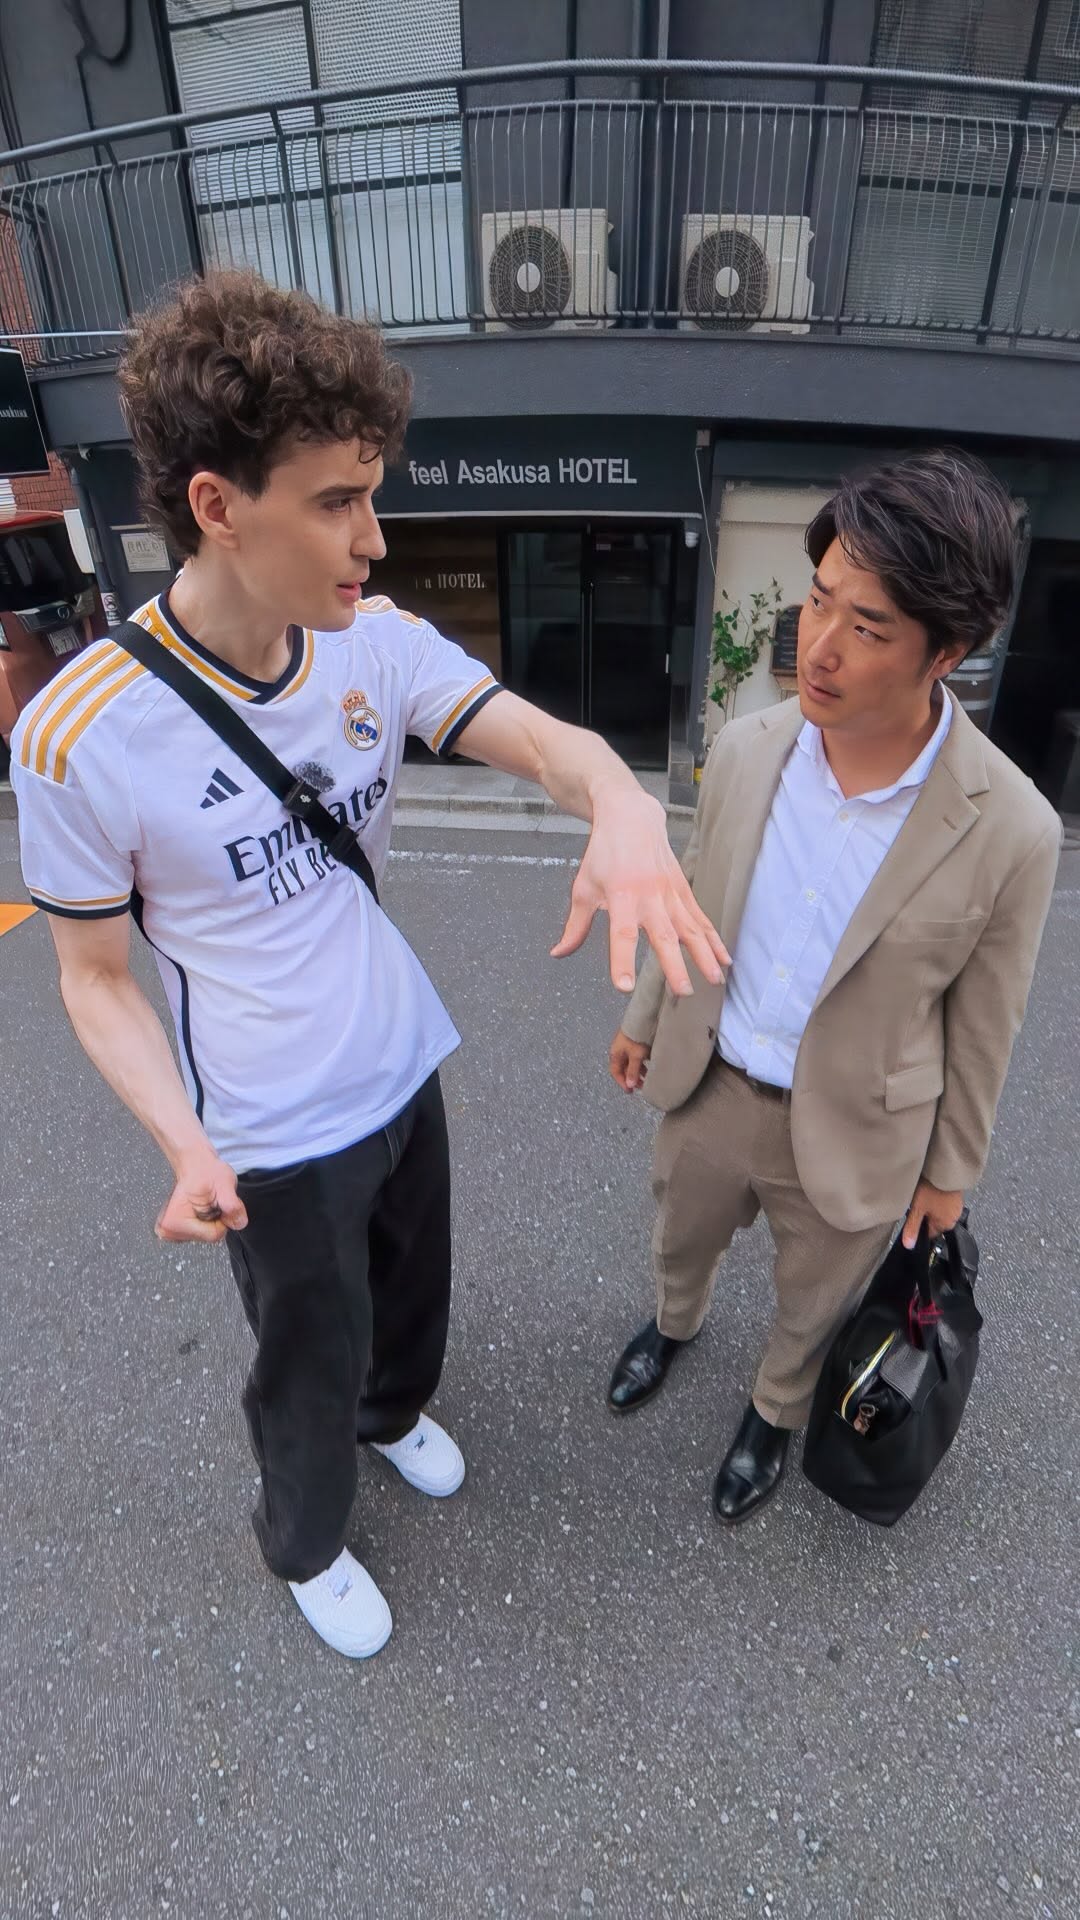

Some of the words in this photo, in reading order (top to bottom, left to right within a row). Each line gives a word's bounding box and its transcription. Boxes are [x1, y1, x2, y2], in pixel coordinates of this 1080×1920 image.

[408, 460, 449, 485] feel
[457, 459, 551, 484] Asakusa
[558, 457, 637, 484] HOTEL
[223, 777, 388, 882] Emiates
[268, 857, 306, 906] FLY
